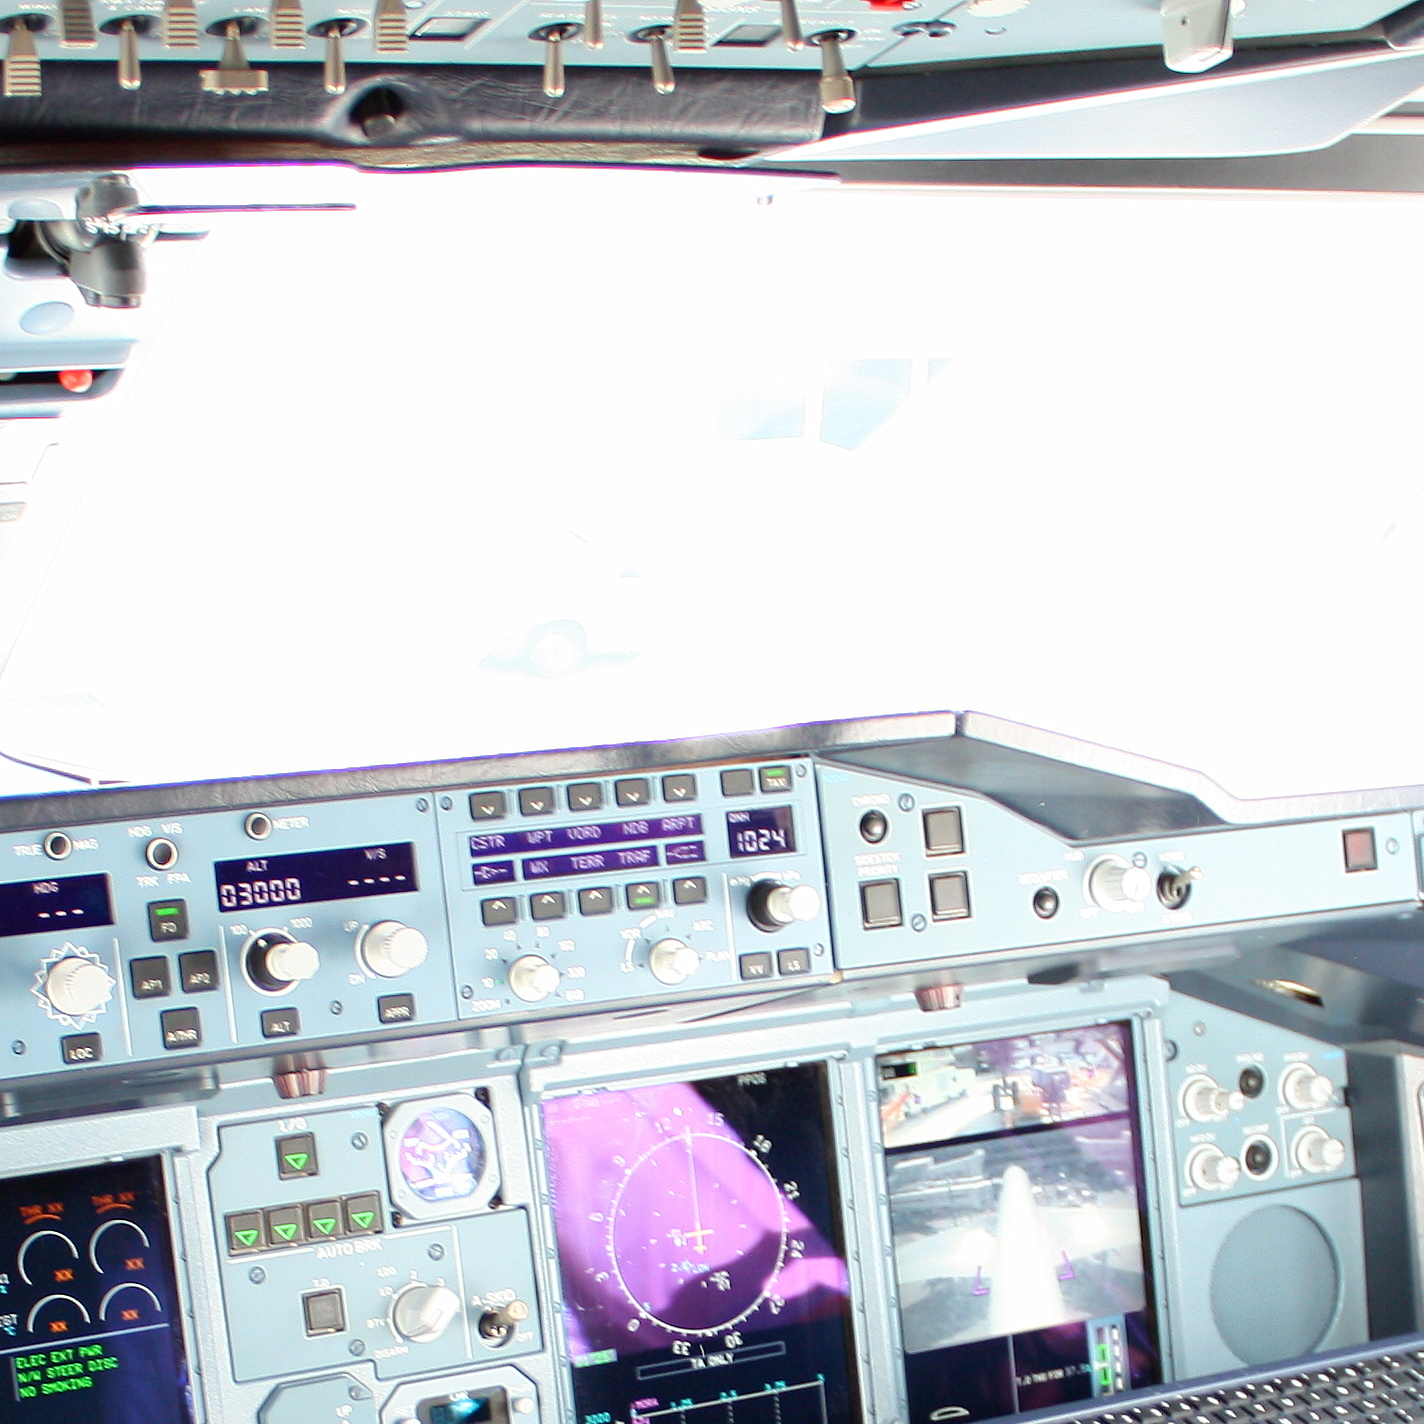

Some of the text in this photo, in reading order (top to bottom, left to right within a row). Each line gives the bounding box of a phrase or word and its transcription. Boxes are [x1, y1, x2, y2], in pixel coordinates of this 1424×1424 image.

[471, 834, 505, 851] CSTR
[623, 821, 648, 835] NDB
[662, 817, 694, 832] ARPT
[738, 831, 786, 851] 1024
[247, 860, 268, 872] ALT
[570, 854, 604, 870] TERR
[618, 849, 650, 865] TRAF
[221, 879, 301, 907] 03000
[16, 1355, 46, 1368] ELEC
[50, 1350, 73, 1362] EXT
[46, 1364, 83, 1378] STEER
[88, 1357, 119, 1371] DISC
[19, 1376, 94, 1397] NO SMOKING
